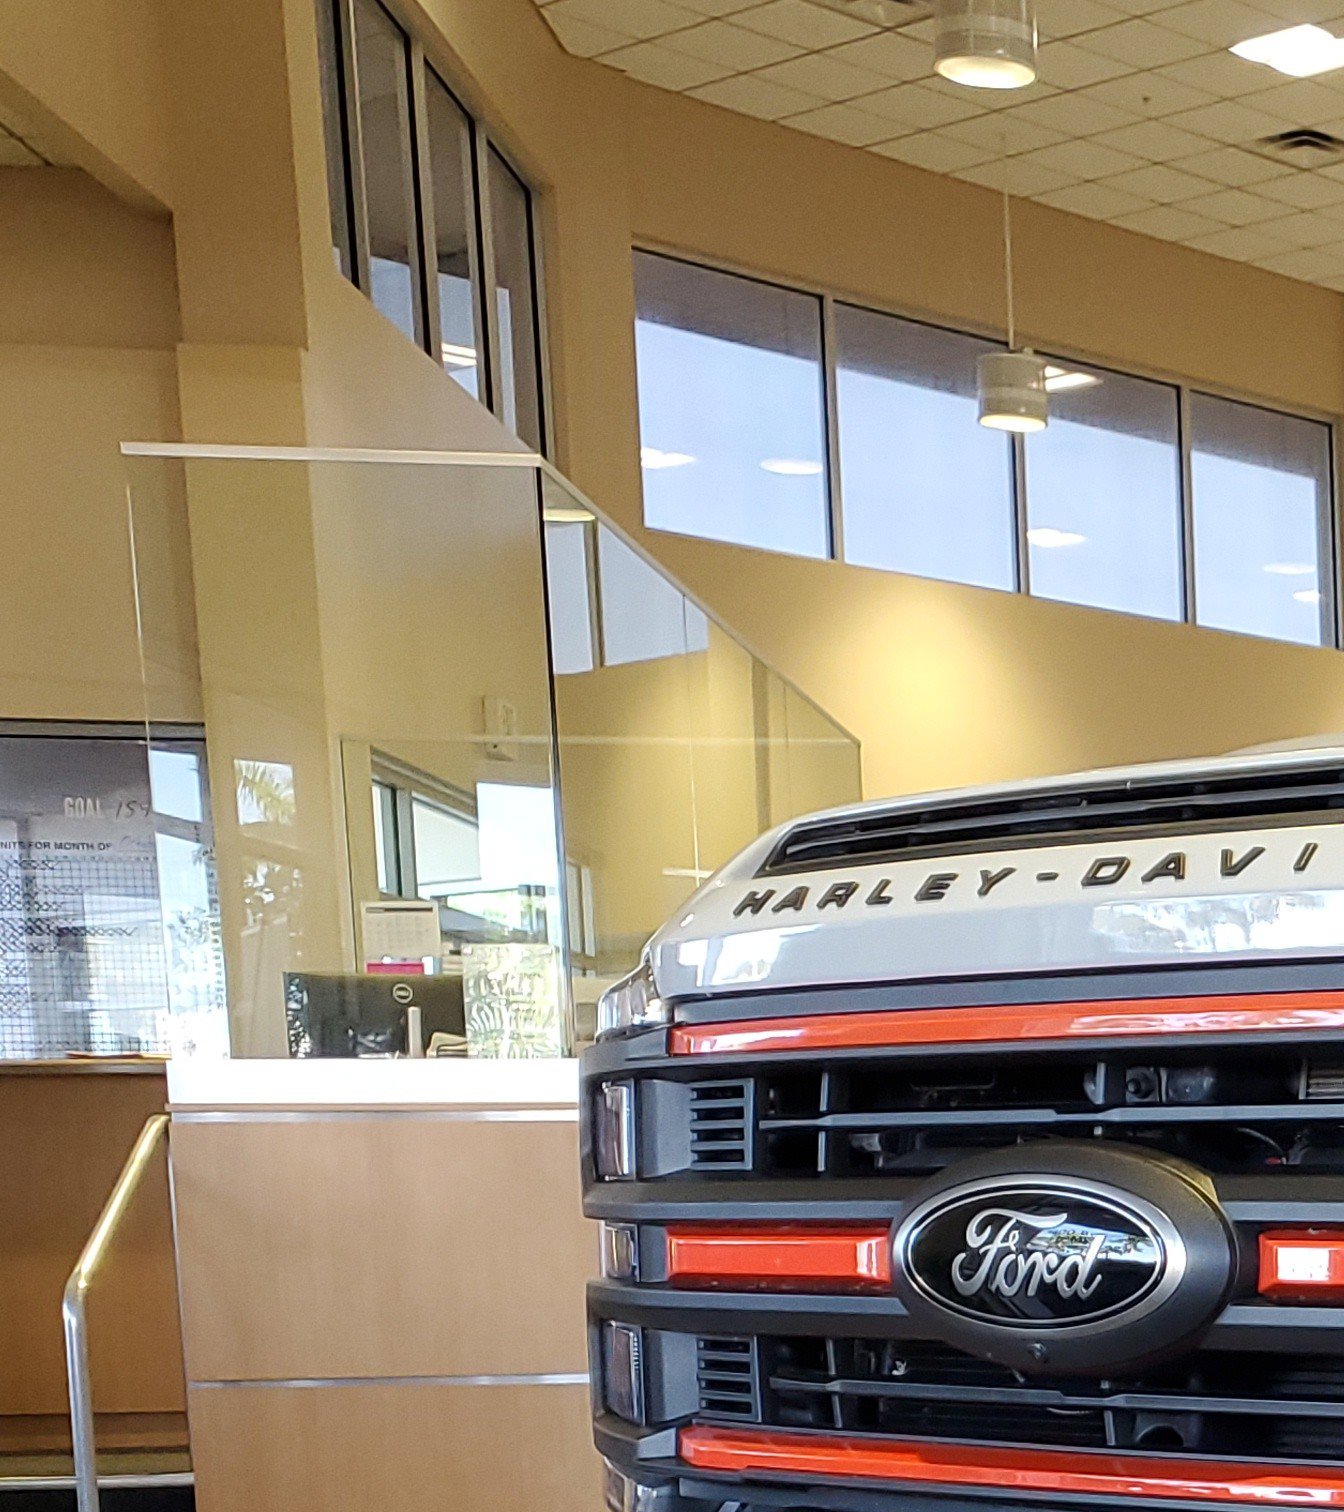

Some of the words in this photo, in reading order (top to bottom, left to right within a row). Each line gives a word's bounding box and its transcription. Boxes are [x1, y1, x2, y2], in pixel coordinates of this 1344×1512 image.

[64, 797, 104, 818] GOAL
[28, 841, 51, 850] FOR
[55, 842, 94, 850] MONTH
[951, 1208, 1102, 1300] Ford
